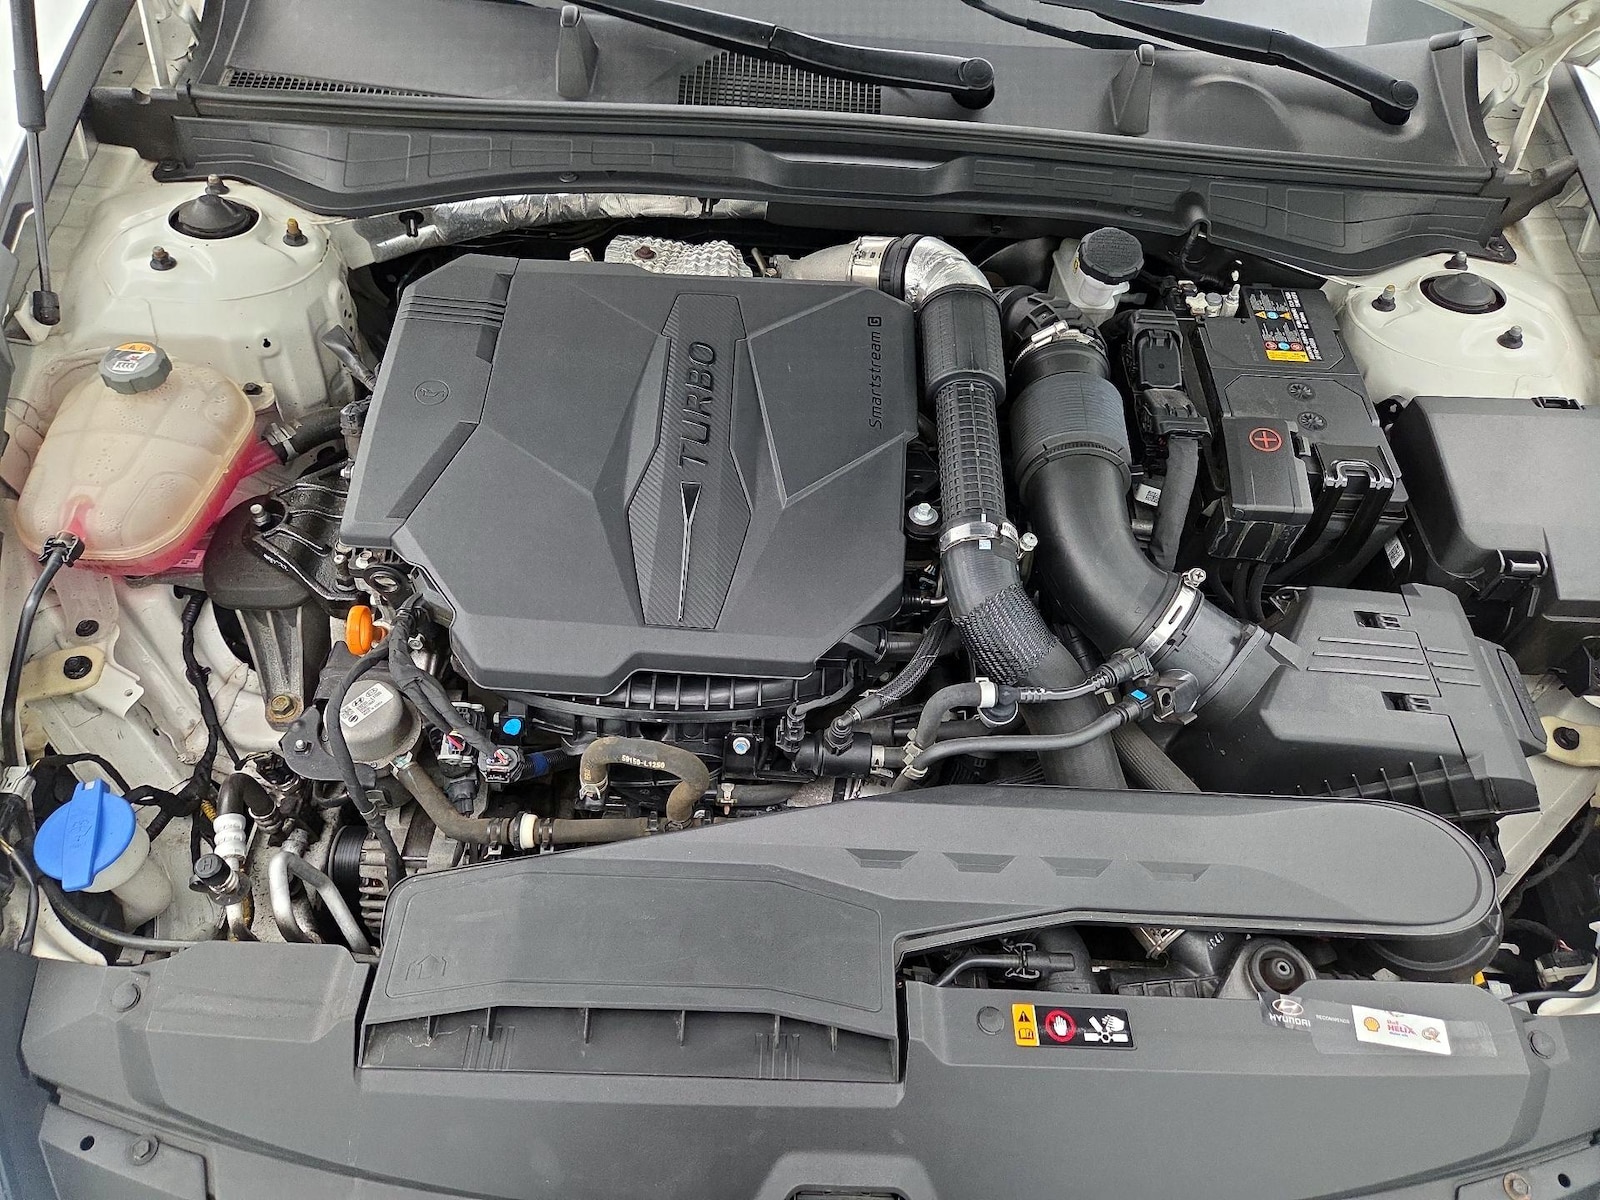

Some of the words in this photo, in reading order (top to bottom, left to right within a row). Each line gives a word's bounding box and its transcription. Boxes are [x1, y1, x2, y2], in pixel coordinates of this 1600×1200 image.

[677, 341, 716, 468] TURBO
[868, 331, 882, 430] Smartstream
[1268, 1012, 1312, 1027] HYUNDAI
[1387, 1024, 1416, 1036] HELIX
